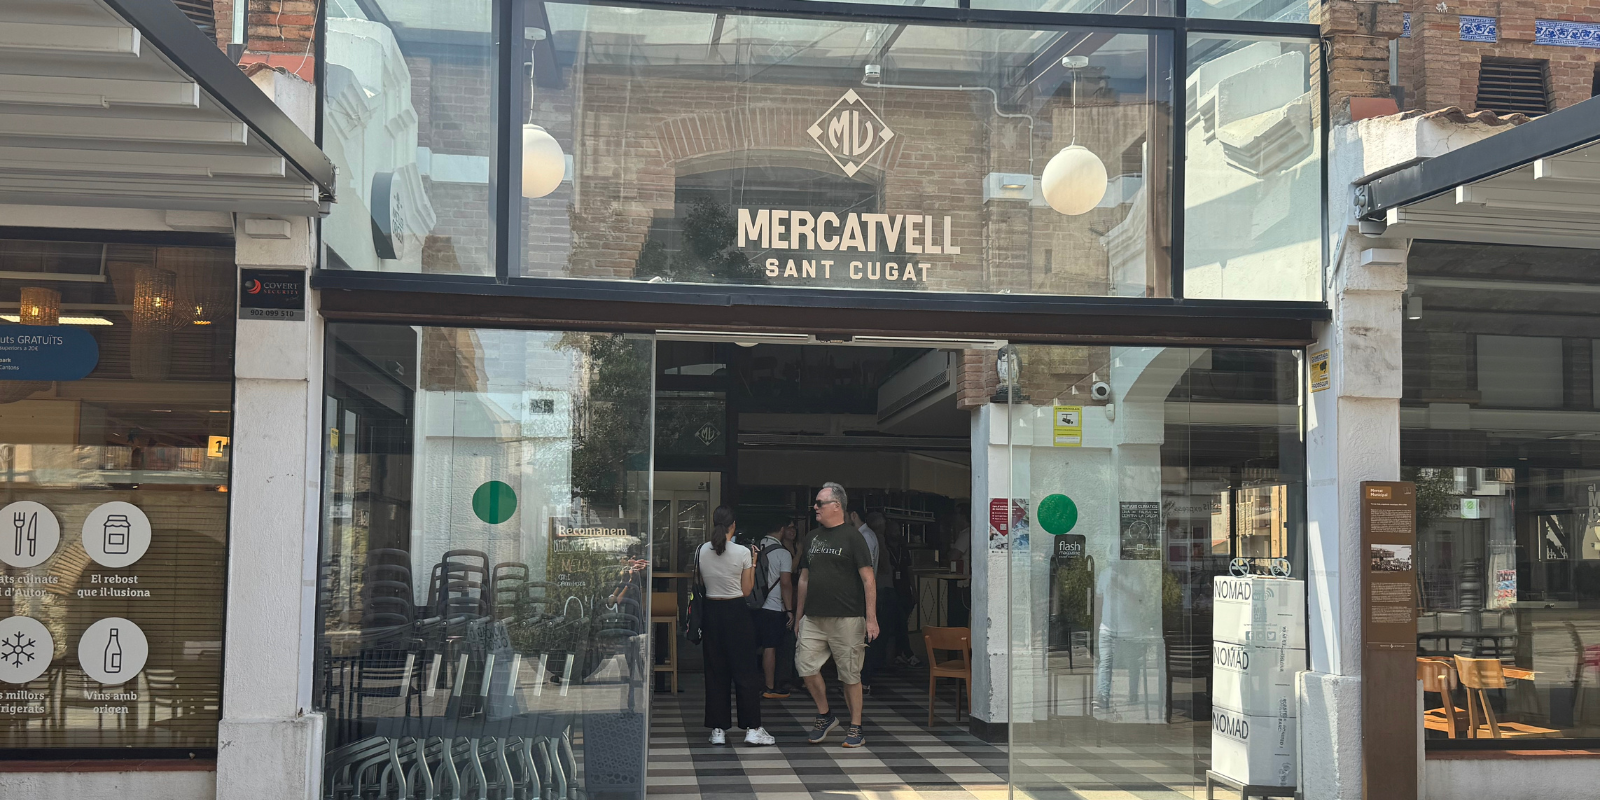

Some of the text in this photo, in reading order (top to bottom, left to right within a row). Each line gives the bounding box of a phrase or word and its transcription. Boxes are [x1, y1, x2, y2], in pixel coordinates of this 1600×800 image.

[737, 208, 961, 255] MERCATVELL
[765, 258, 932, 282] SANT CUGAT
[263, 282, 298, 290] COVERT
[17, 334, 63, 345] GRATUÏTS
[557, 525, 627, 536] Recomanem
[1058, 540, 1081, 551] flash
[17, 574, 59, 584] cuinats
[91, 574, 139, 584] El rebost
[77, 587, 151, 600] que il·lusiona
[1215, 580, 1252, 600] NOMAD
[1213, 646, 1249, 670] NOMAD
[5, 690, 45, 700] millors
[86, 690, 138, 700] Vins amb
[0, 703, 45, 715] rigerats
[93, 704, 129, 714] origen
[1212, 711, 1249, 740] NOMAD
